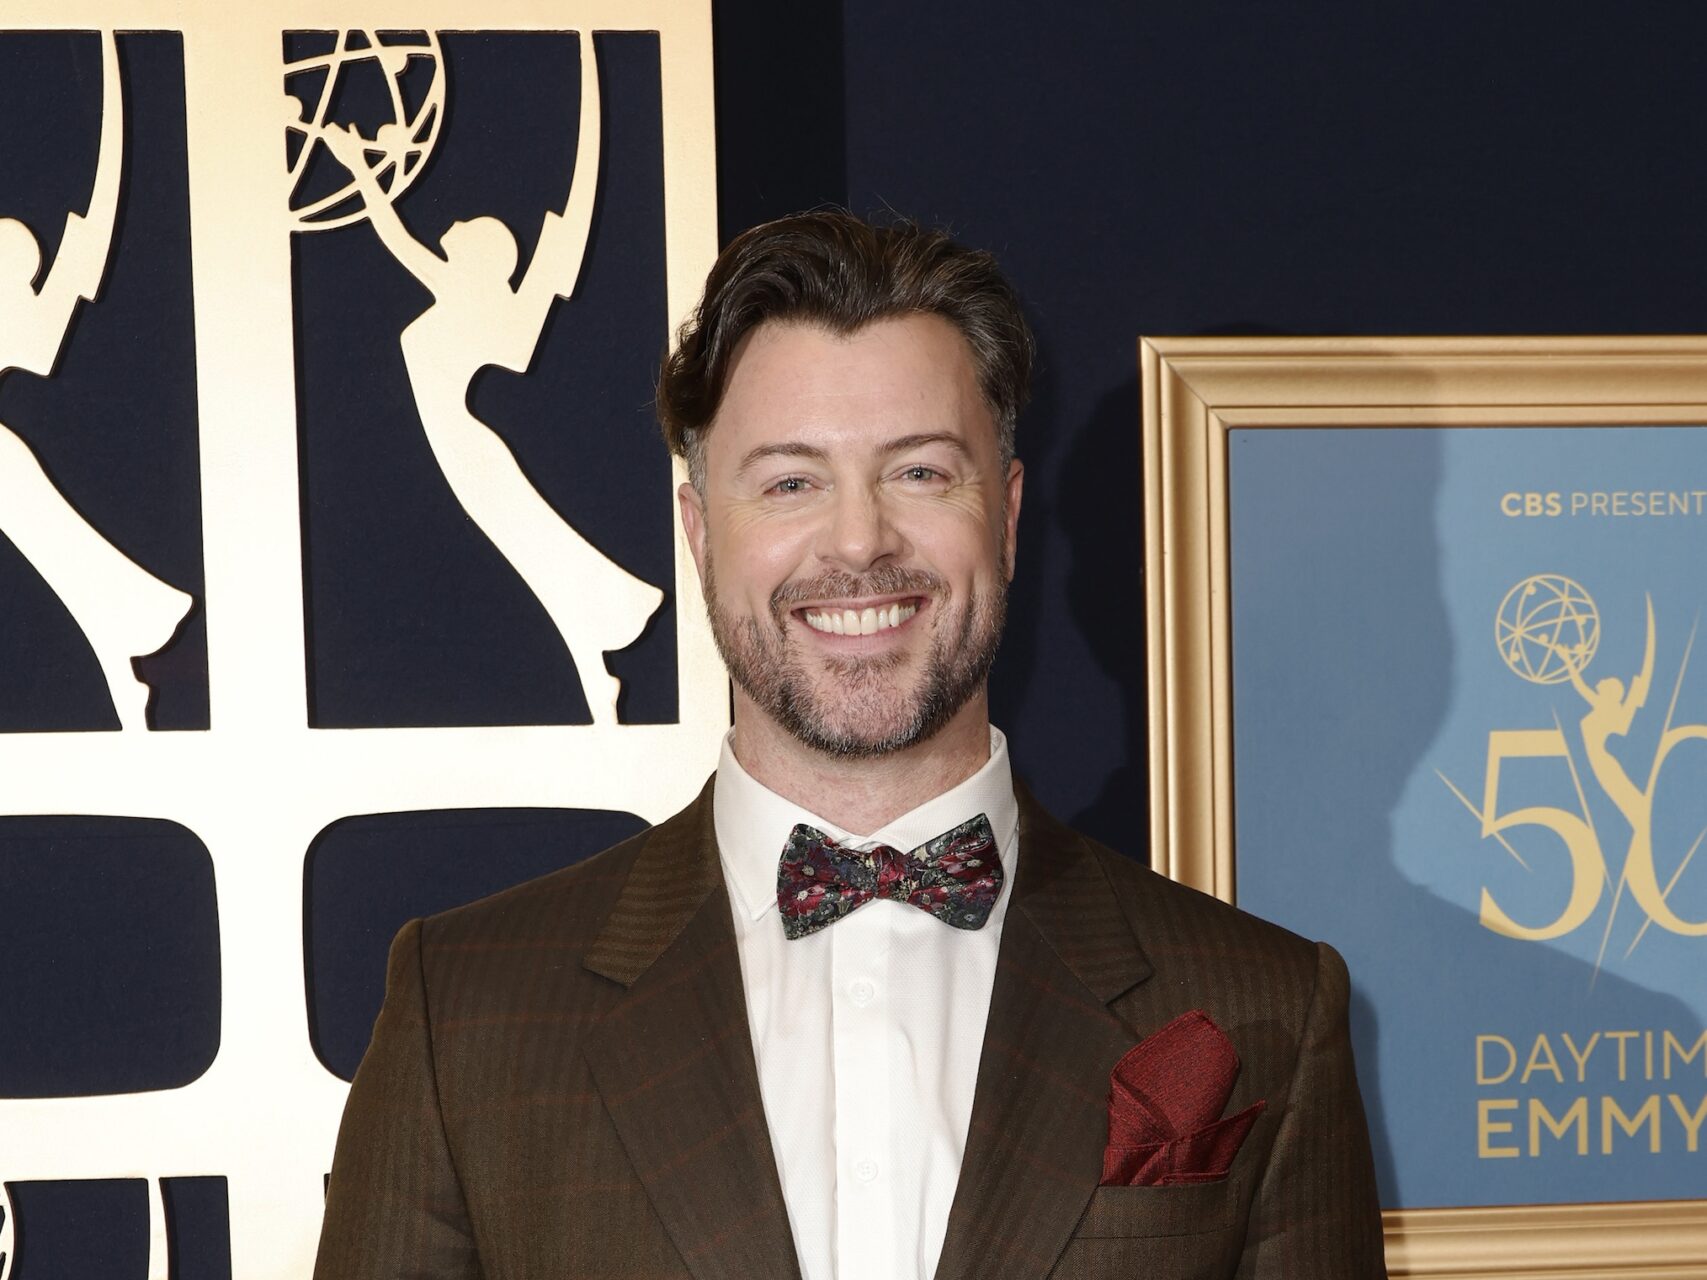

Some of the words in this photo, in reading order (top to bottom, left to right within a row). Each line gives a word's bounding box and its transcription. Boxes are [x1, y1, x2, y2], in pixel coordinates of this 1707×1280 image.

[1500, 492, 1562, 517] CBS
[1571, 491, 1707, 516] PRESENT
[1475, 1030, 1707, 1086] DAYTIM
[1477, 1094, 1707, 1159] EMMY
